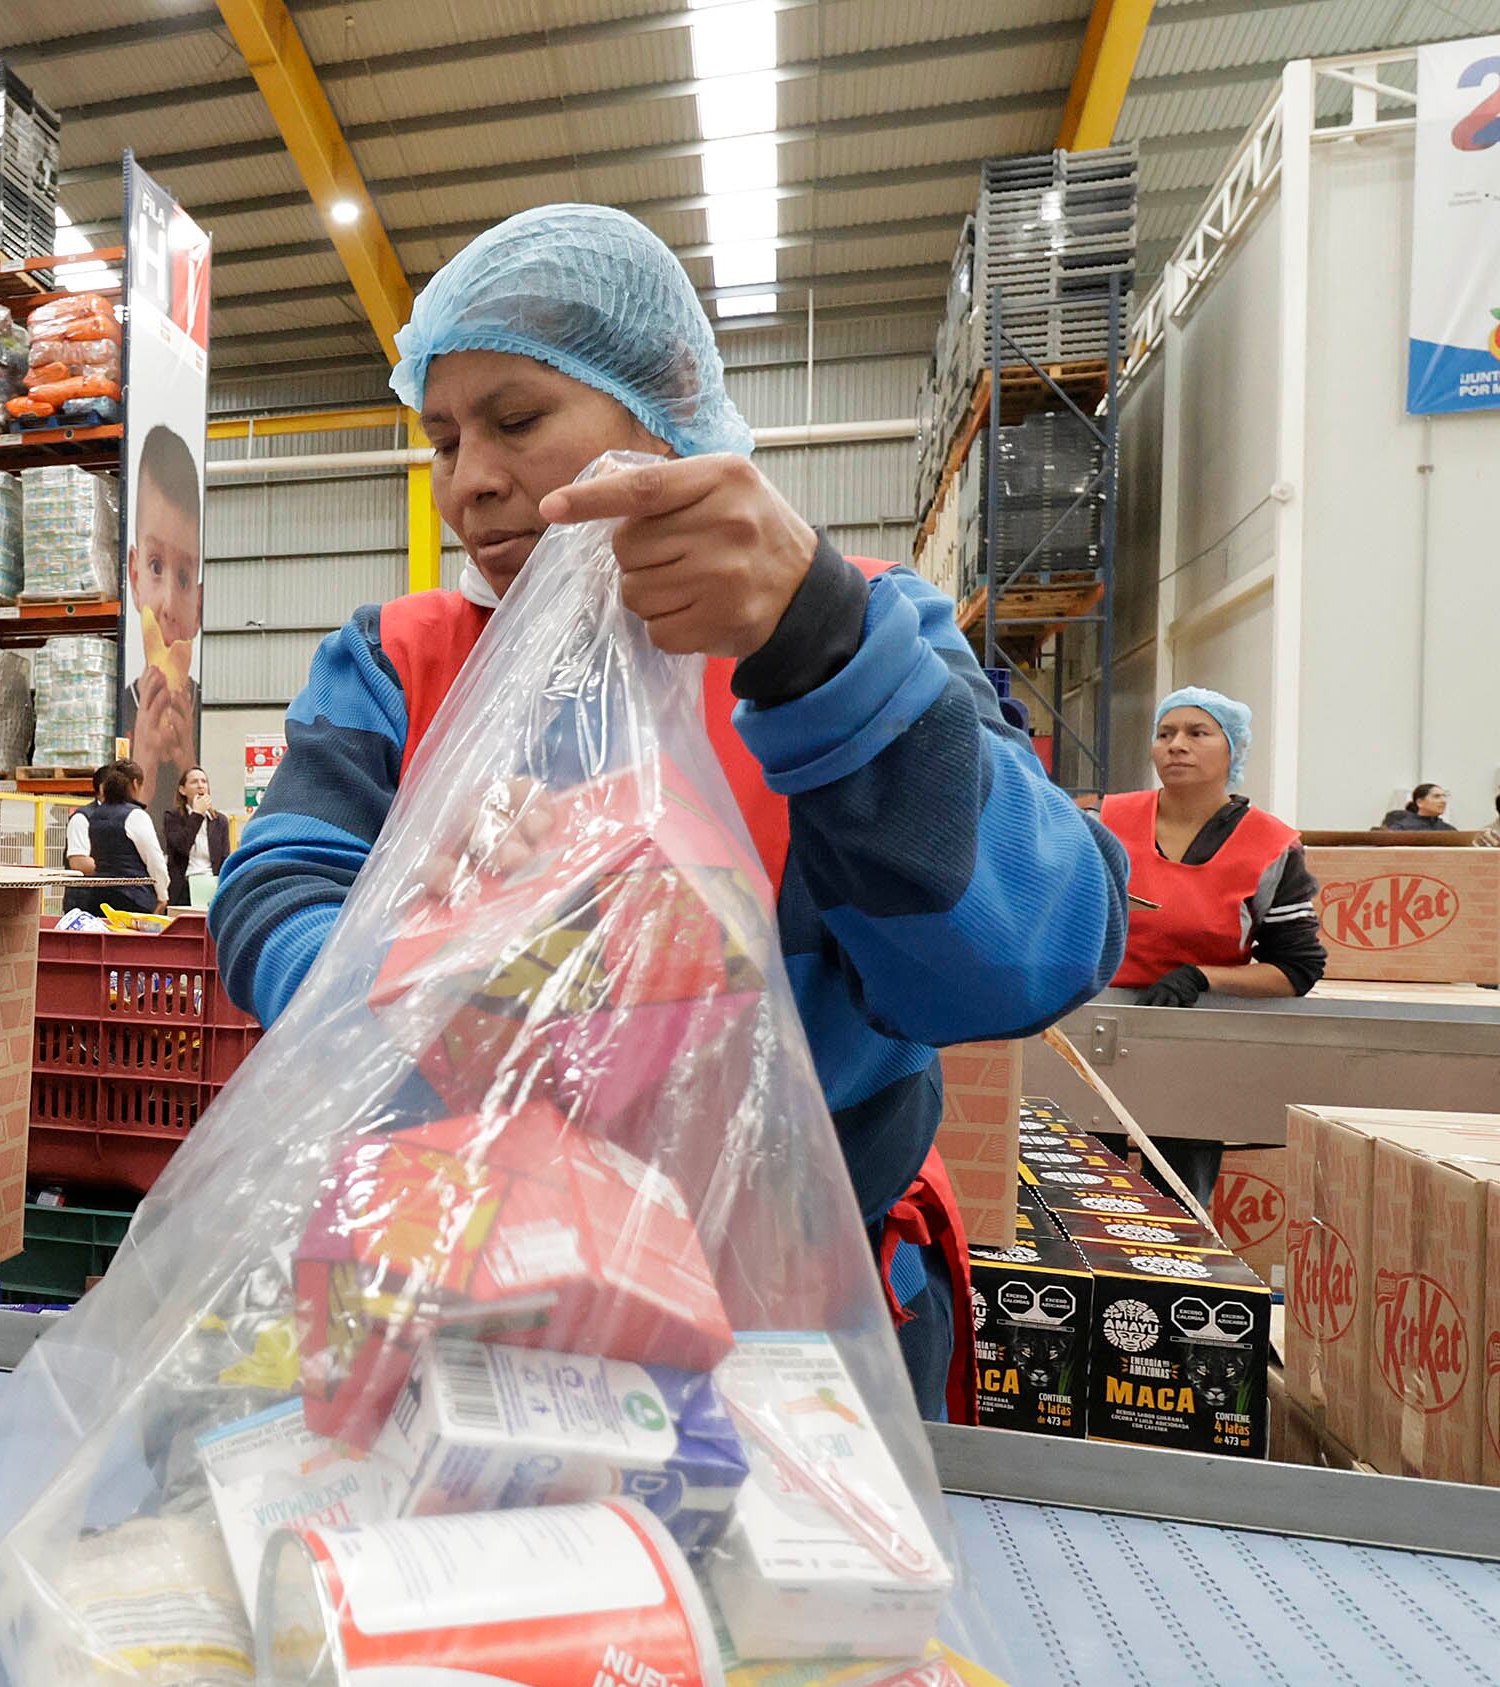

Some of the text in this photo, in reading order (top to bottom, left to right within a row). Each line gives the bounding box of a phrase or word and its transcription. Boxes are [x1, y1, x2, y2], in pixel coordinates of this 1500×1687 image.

[141, 190, 166, 229] FILA
[137, 212, 167, 303] H
[1460, 384, 1490, 397] POR
[1337, 878, 1449, 947] KitKat
[1097, 1217, 1171, 1229] MACA
[1120, 1248, 1203, 1262] MACA
[1292, 1226, 1354, 1340] KitKat
[1103, 1318, 1159, 1335] AMAYU
[1382, 1280, 1462, 1404] KitKat
[1129, 1364, 1171, 1380] AMAZONAS
[1038, 1392, 1072, 1404] CONTIENE
[1106, 1375, 1196, 1414] MACA
[1038, 1400, 1072, 1416] 4 latas
[1037, 1415, 1046, 1424] de
[1046, 1415, 1061, 1426] 473
[1214, 1411, 1251, 1424] CONTIENE
[1214, 1420, 1250, 1436] 4 latas
[1213, 1435, 1223, 1444] de
[1224, 1436, 1240, 1446] 473
